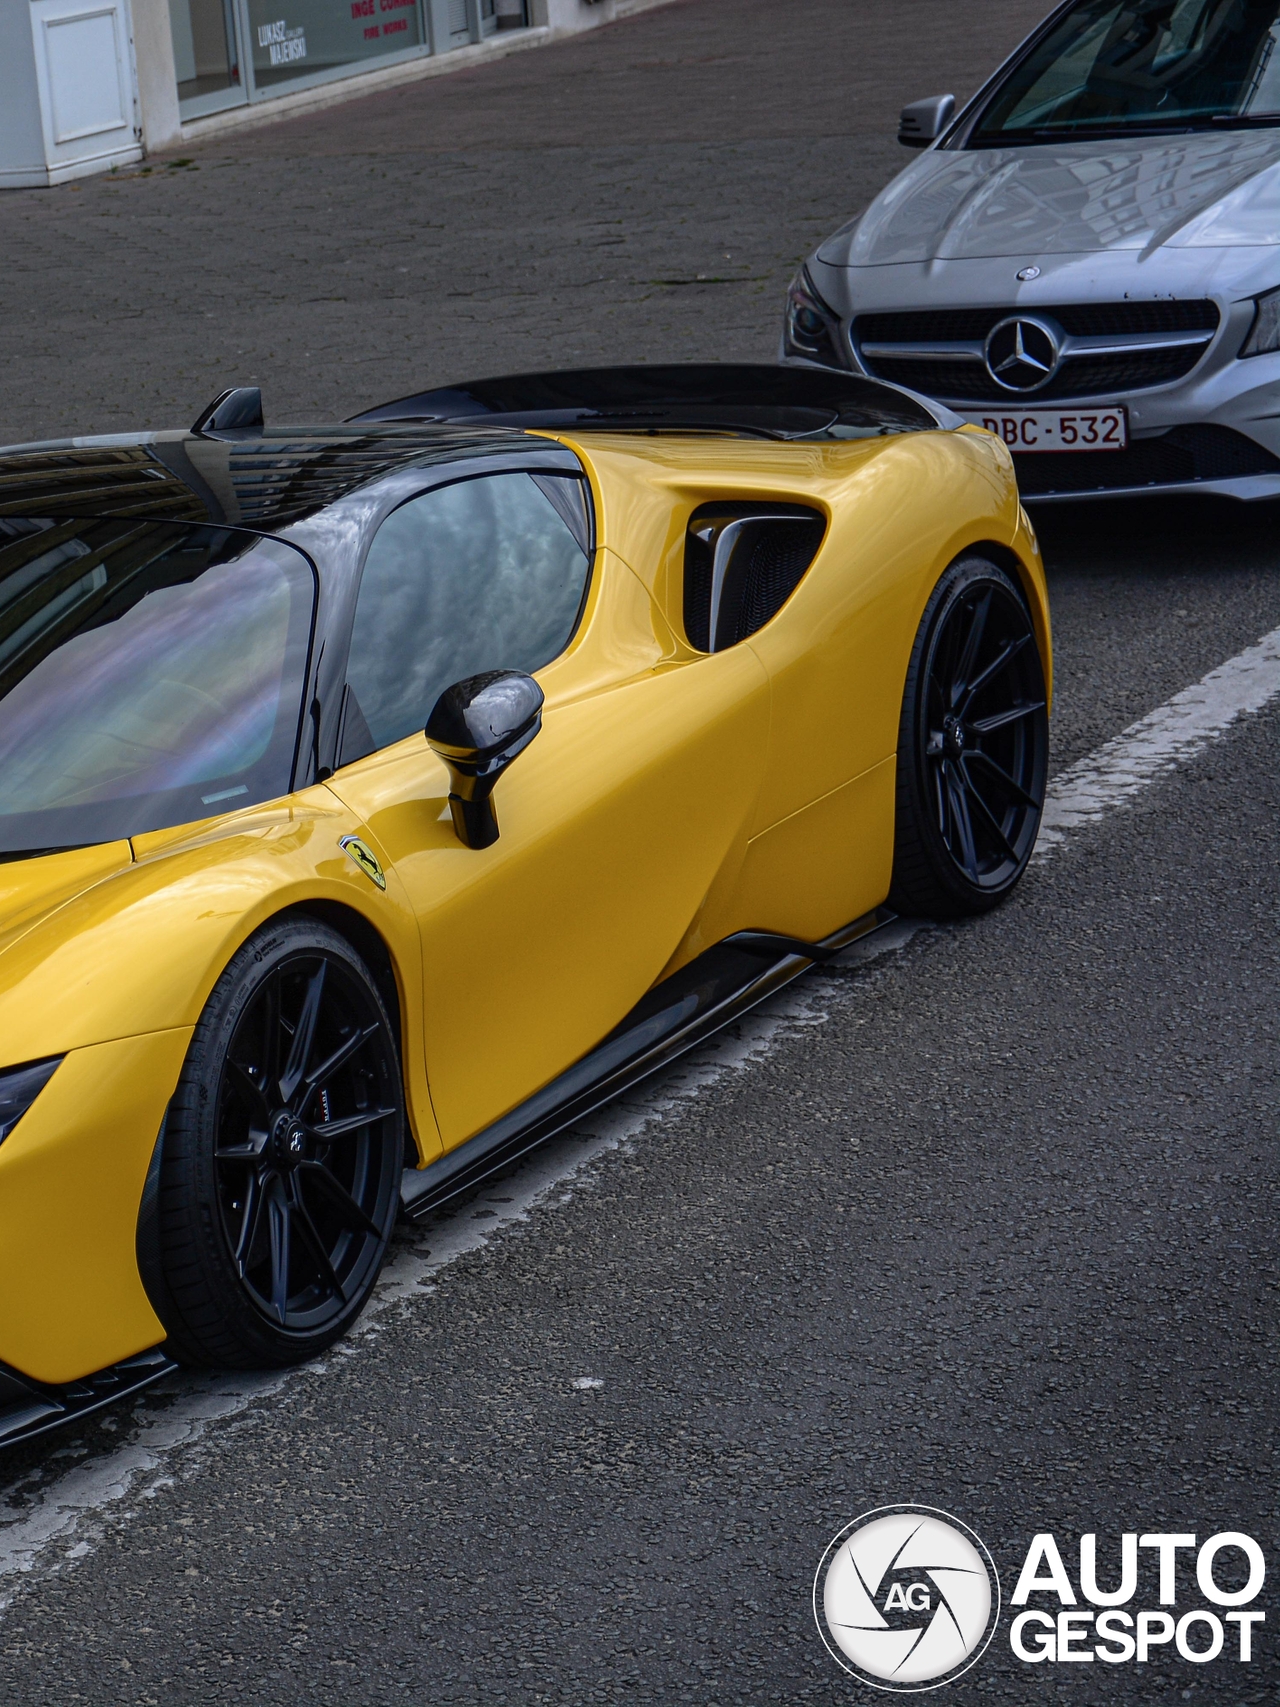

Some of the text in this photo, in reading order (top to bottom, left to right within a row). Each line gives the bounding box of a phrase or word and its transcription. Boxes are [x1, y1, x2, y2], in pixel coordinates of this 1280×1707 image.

[351, 0, 375, 19] INGE
[364, 19, 407, 40] FIRE WORKS
[982, 415, 1120, 446] DBC-532
